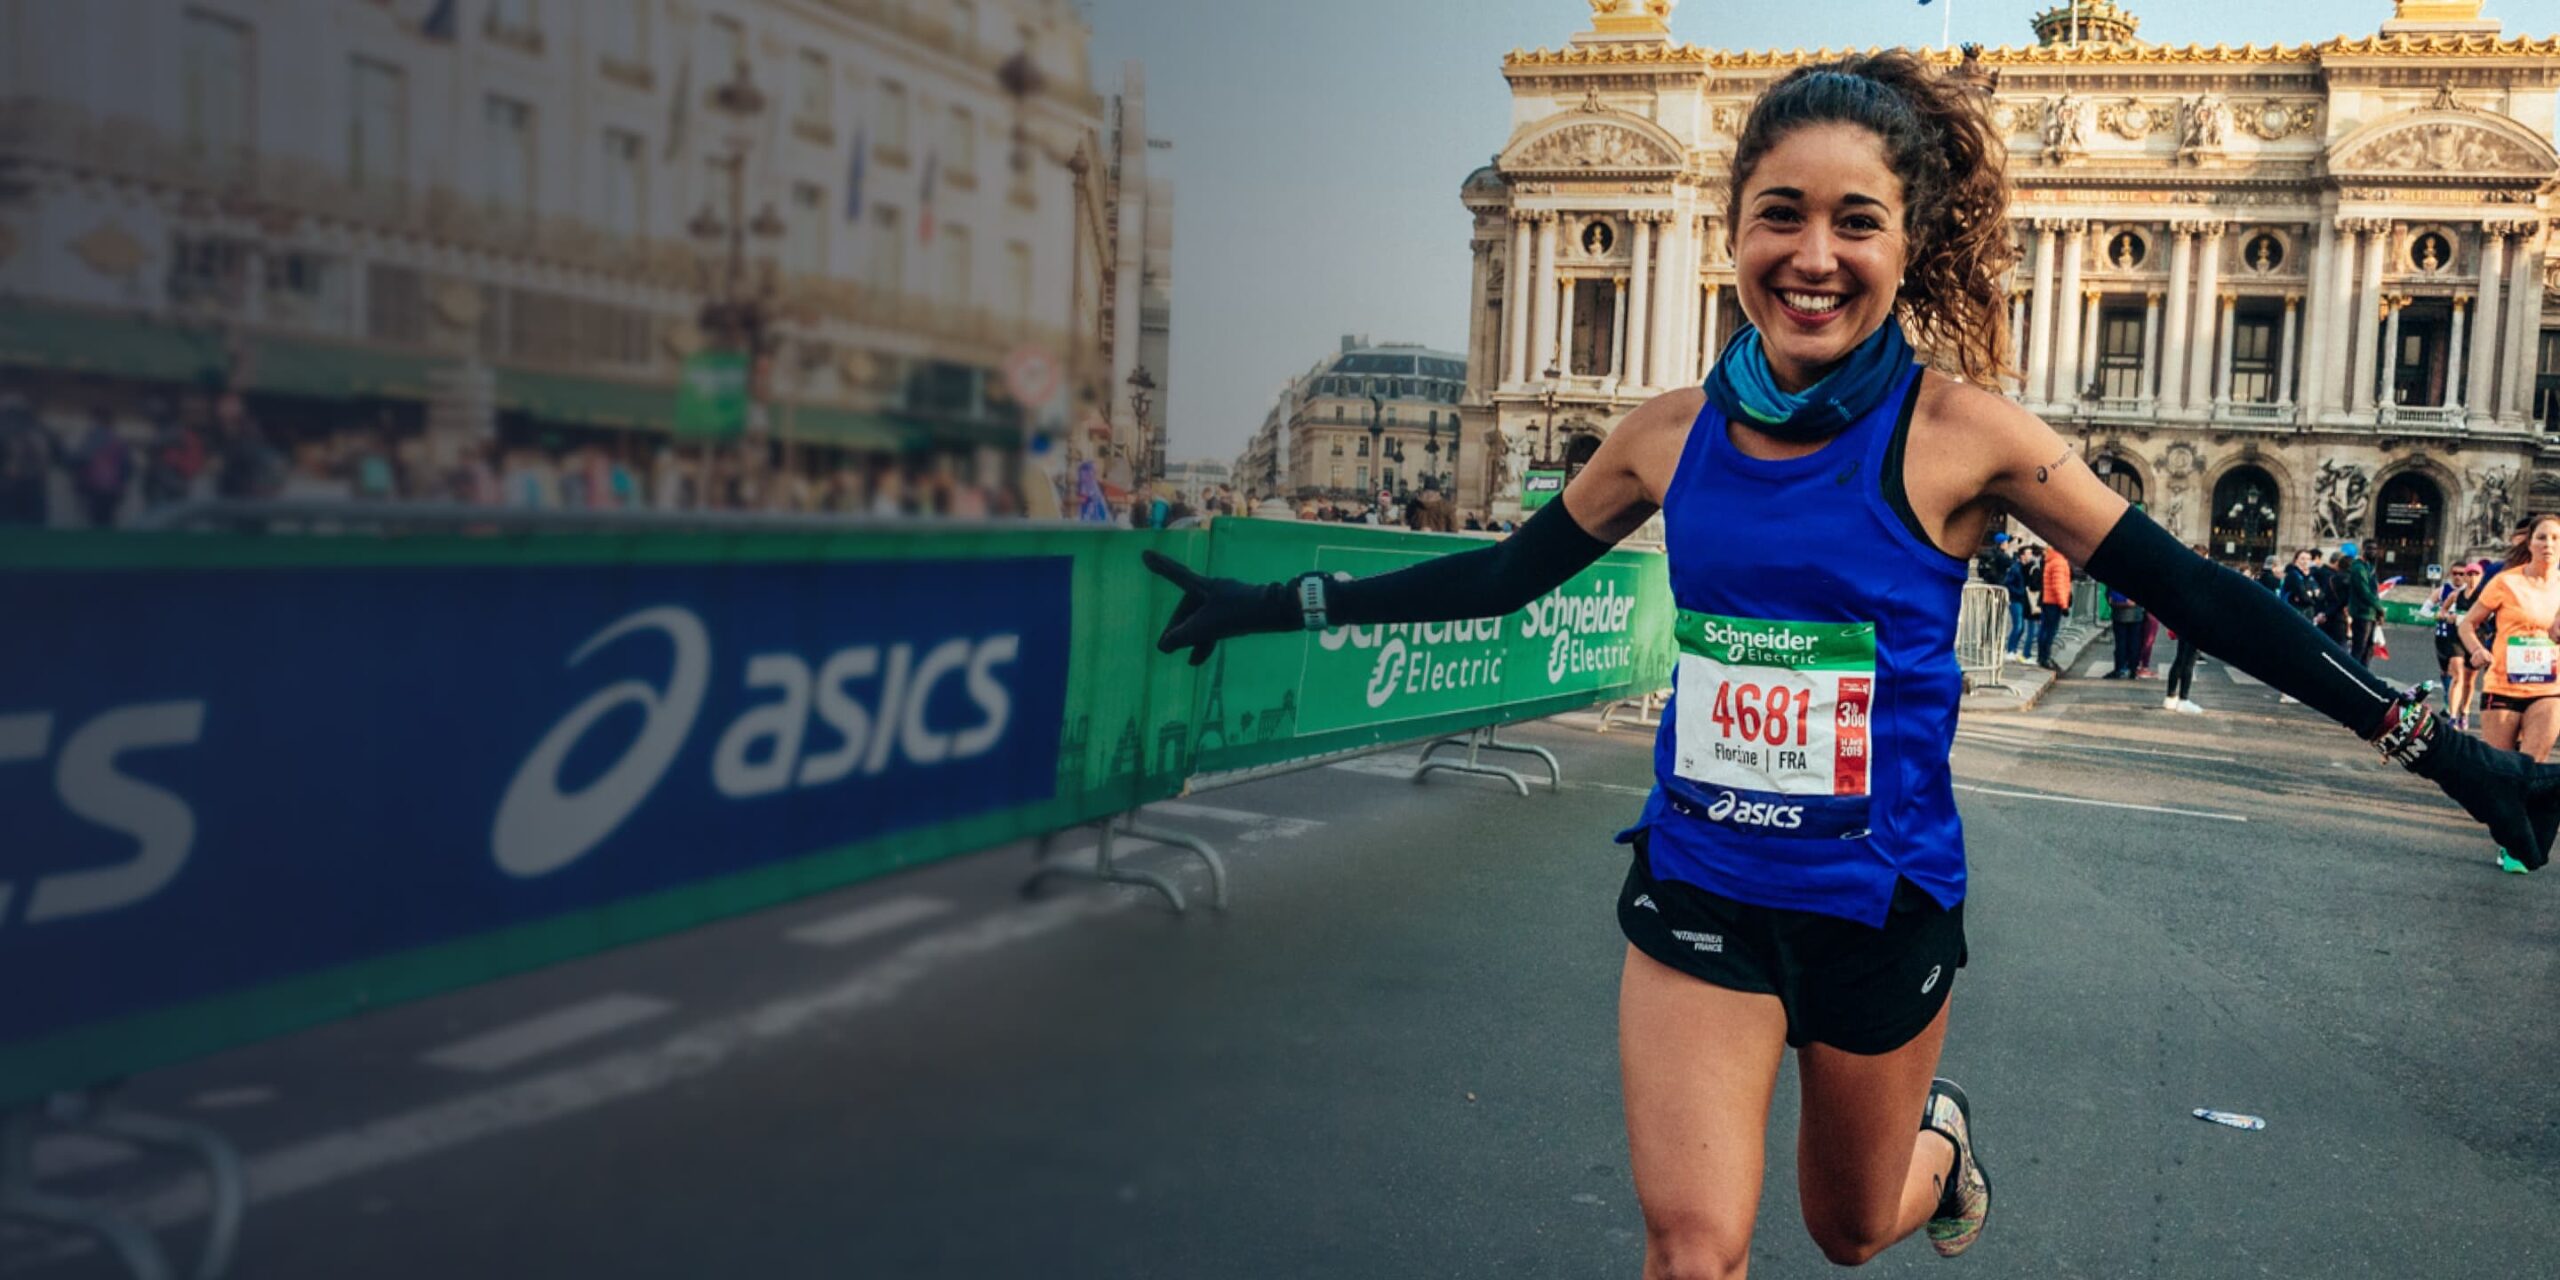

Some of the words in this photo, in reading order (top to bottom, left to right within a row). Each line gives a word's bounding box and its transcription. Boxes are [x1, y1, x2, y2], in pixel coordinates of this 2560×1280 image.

[1521, 580, 1635, 638] Schneider
[1704, 621, 1818, 650] Schneider
[1570, 638, 1631, 673] Electric
[1748, 648, 1816, 664] Electric
[1406, 650, 1502, 694] Electric
[1712, 681, 1811, 746] 4681
[1779, 751, 1807, 770] FRA
[1733, 801, 1804, 829] asics
